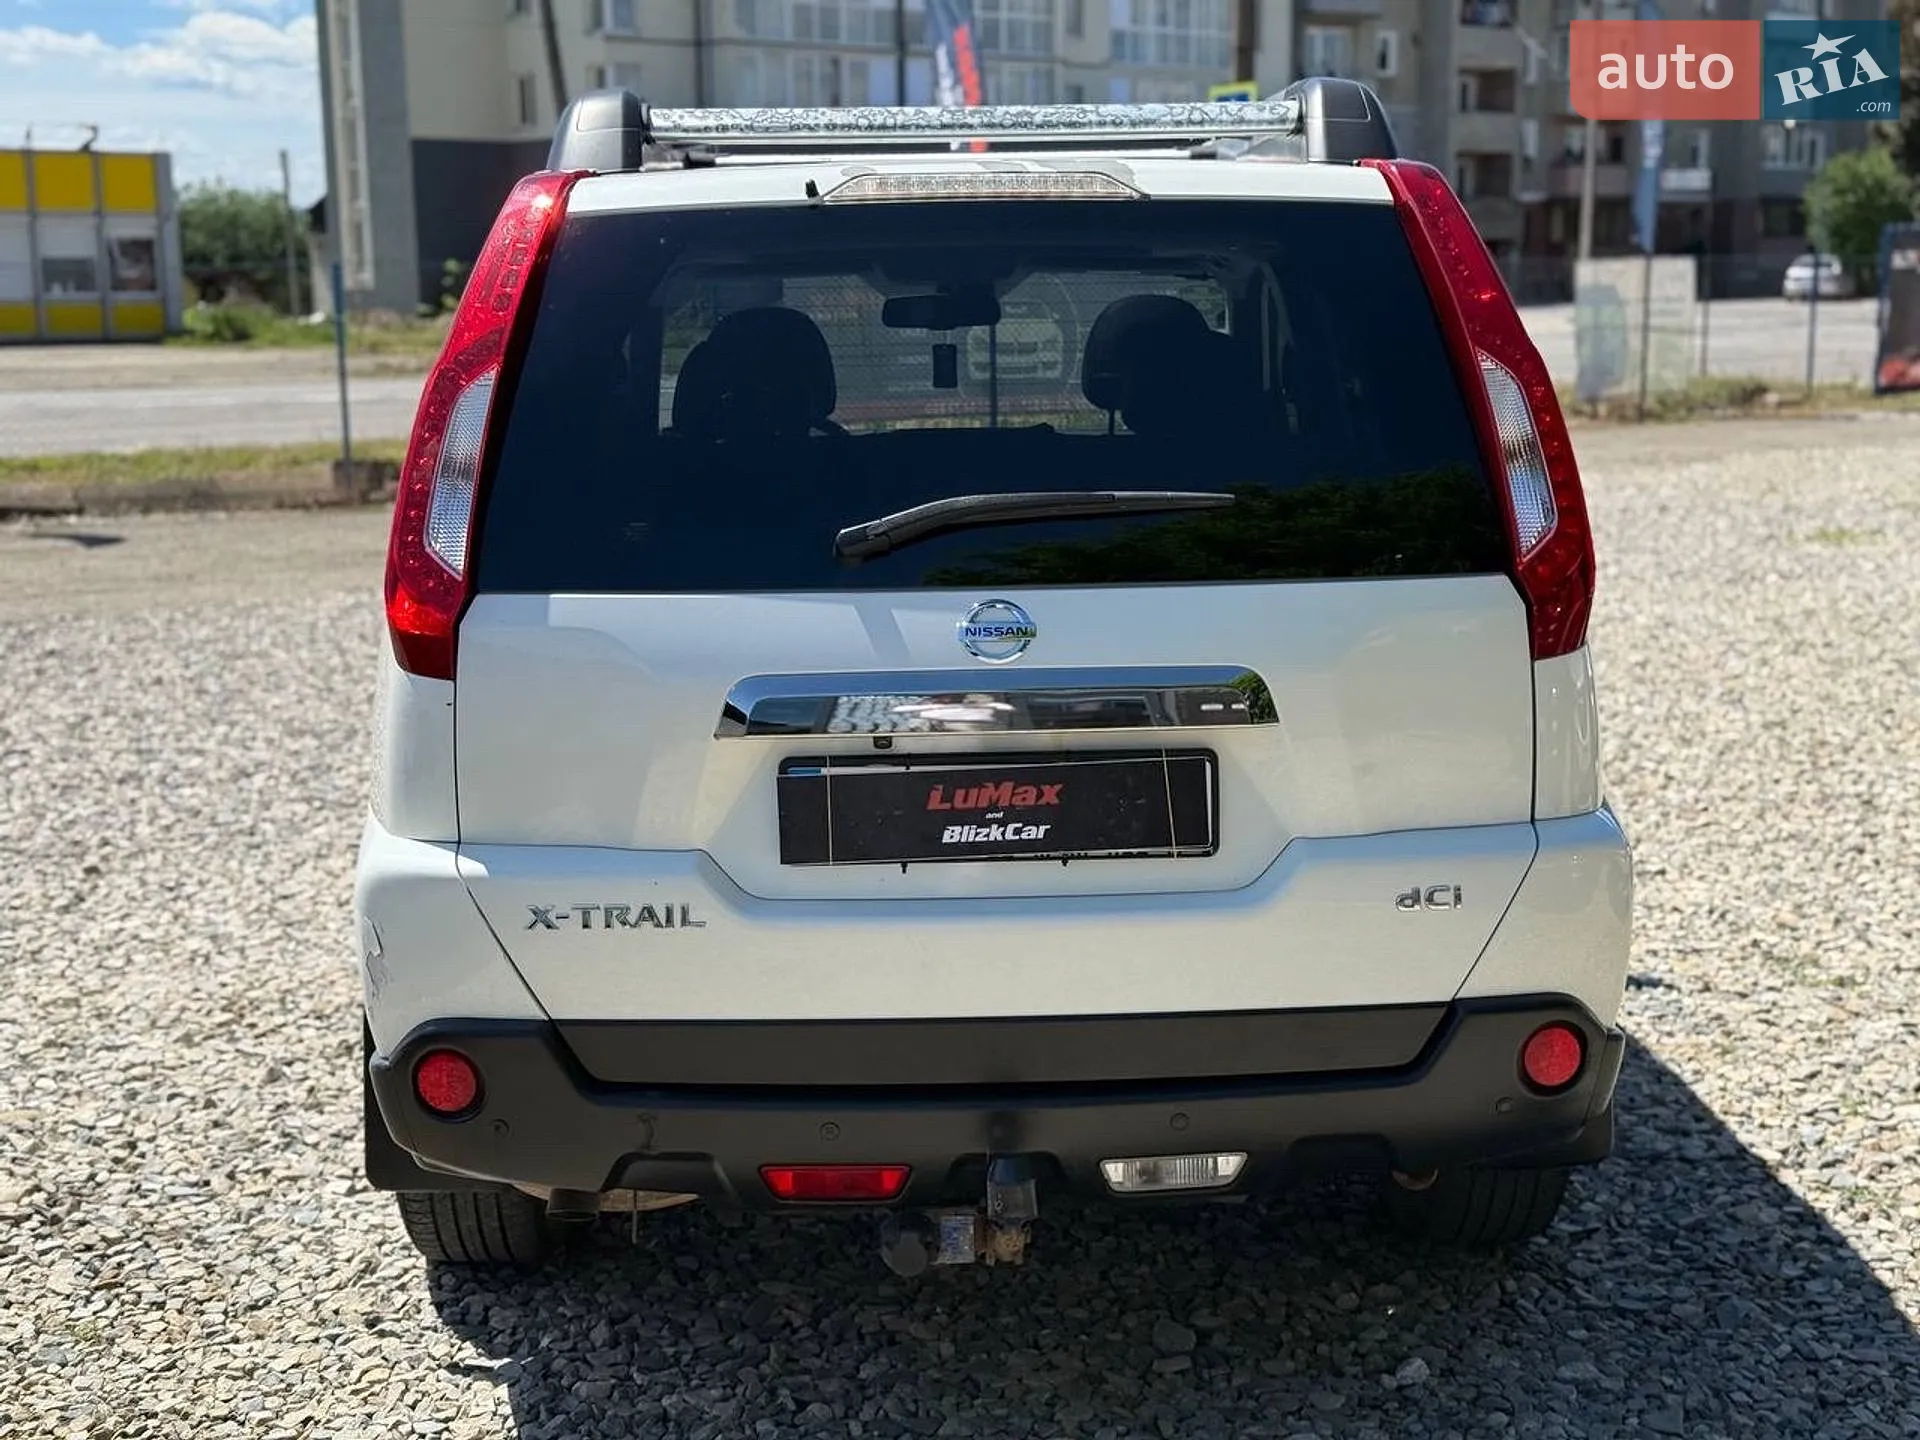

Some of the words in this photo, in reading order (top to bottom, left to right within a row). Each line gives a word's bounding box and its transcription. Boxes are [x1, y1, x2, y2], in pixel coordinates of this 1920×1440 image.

[965, 626, 1029, 637] NISSAN
[926, 781, 1064, 811] LuMax
[985, 811, 1004, 819] and
[942, 822, 1051, 843] BlizkCar
[1395, 884, 1462, 912] dCi
[525, 902, 707, 930] X-TRAIL
